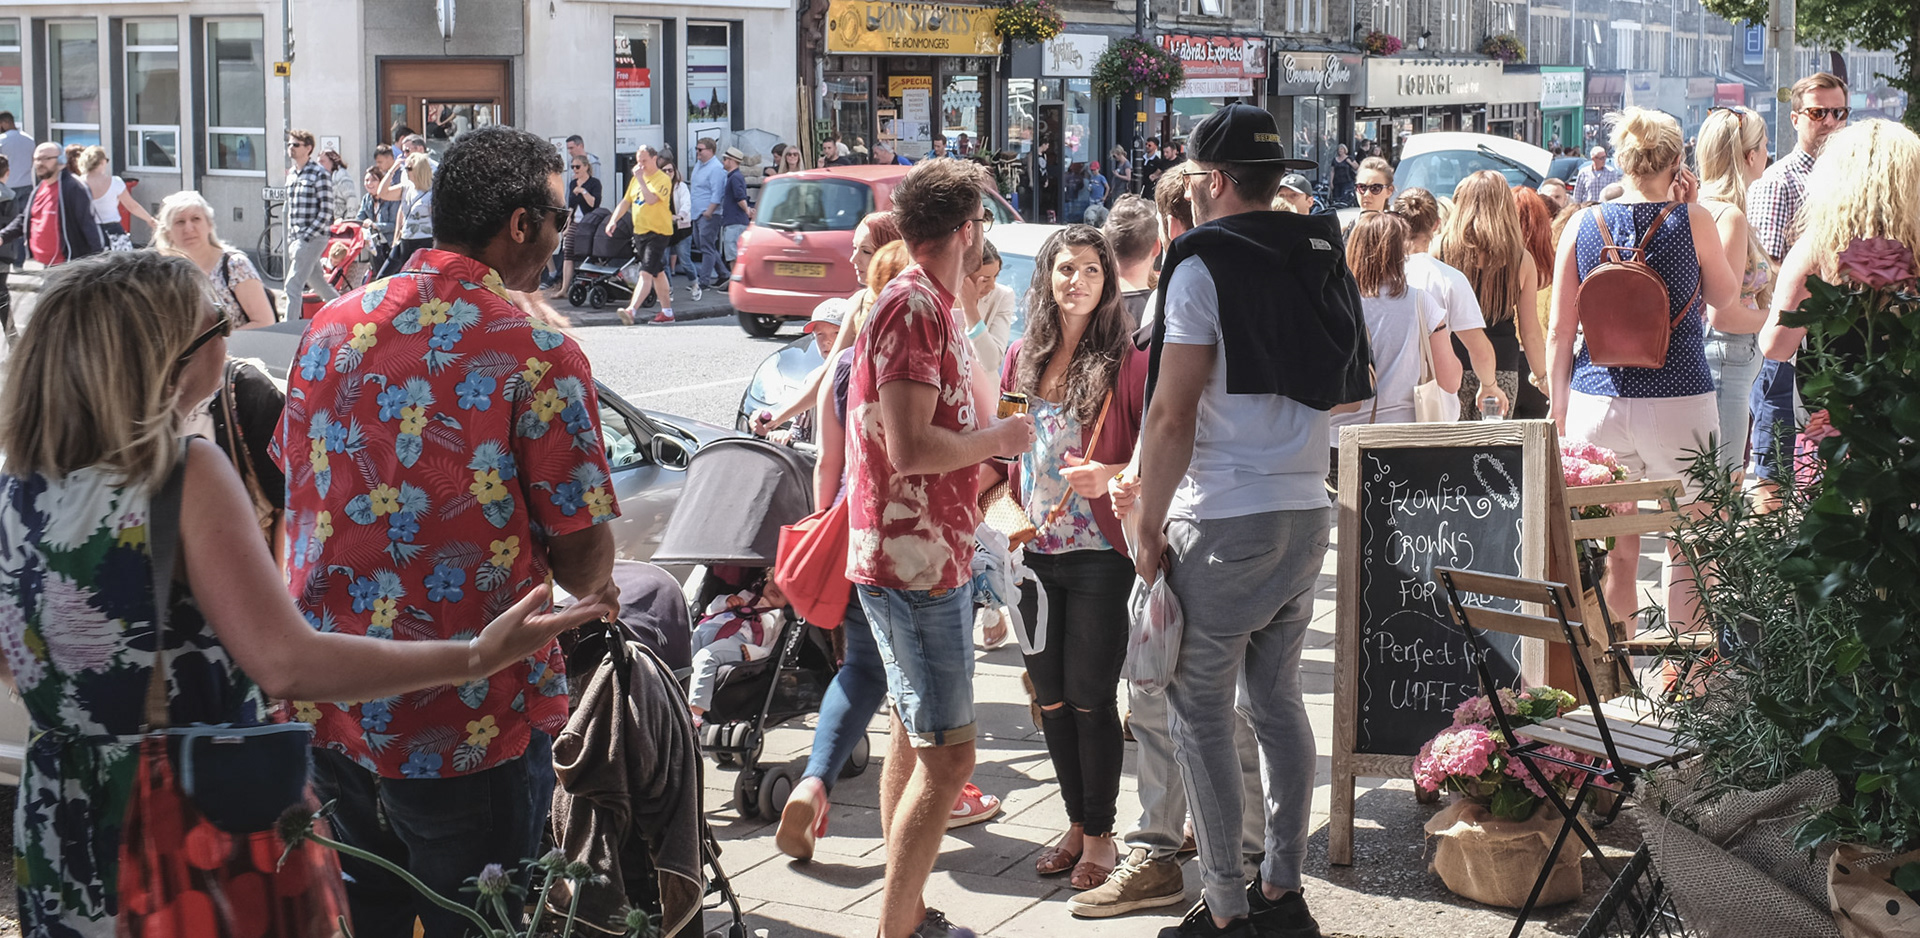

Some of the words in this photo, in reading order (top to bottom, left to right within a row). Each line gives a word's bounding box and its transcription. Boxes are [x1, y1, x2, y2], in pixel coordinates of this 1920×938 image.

[887, 36, 900, 48] THE
[902, 37, 950, 50] IRONMONGERS
[1206, 41, 1242, 64] Express
[616, 71, 629, 79] Free
[1283, 54, 1324, 94] Crowning
[264, 189, 284, 199] TRUR
[1381, 473, 1492, 526] FLOWER
[1385, 521, 1474, 572] CROWNS
[1399, 577, 1445, 617] FOR
[1372, 631, 1456, 672] Perfect
[1459, 641, 1491, 674] for
